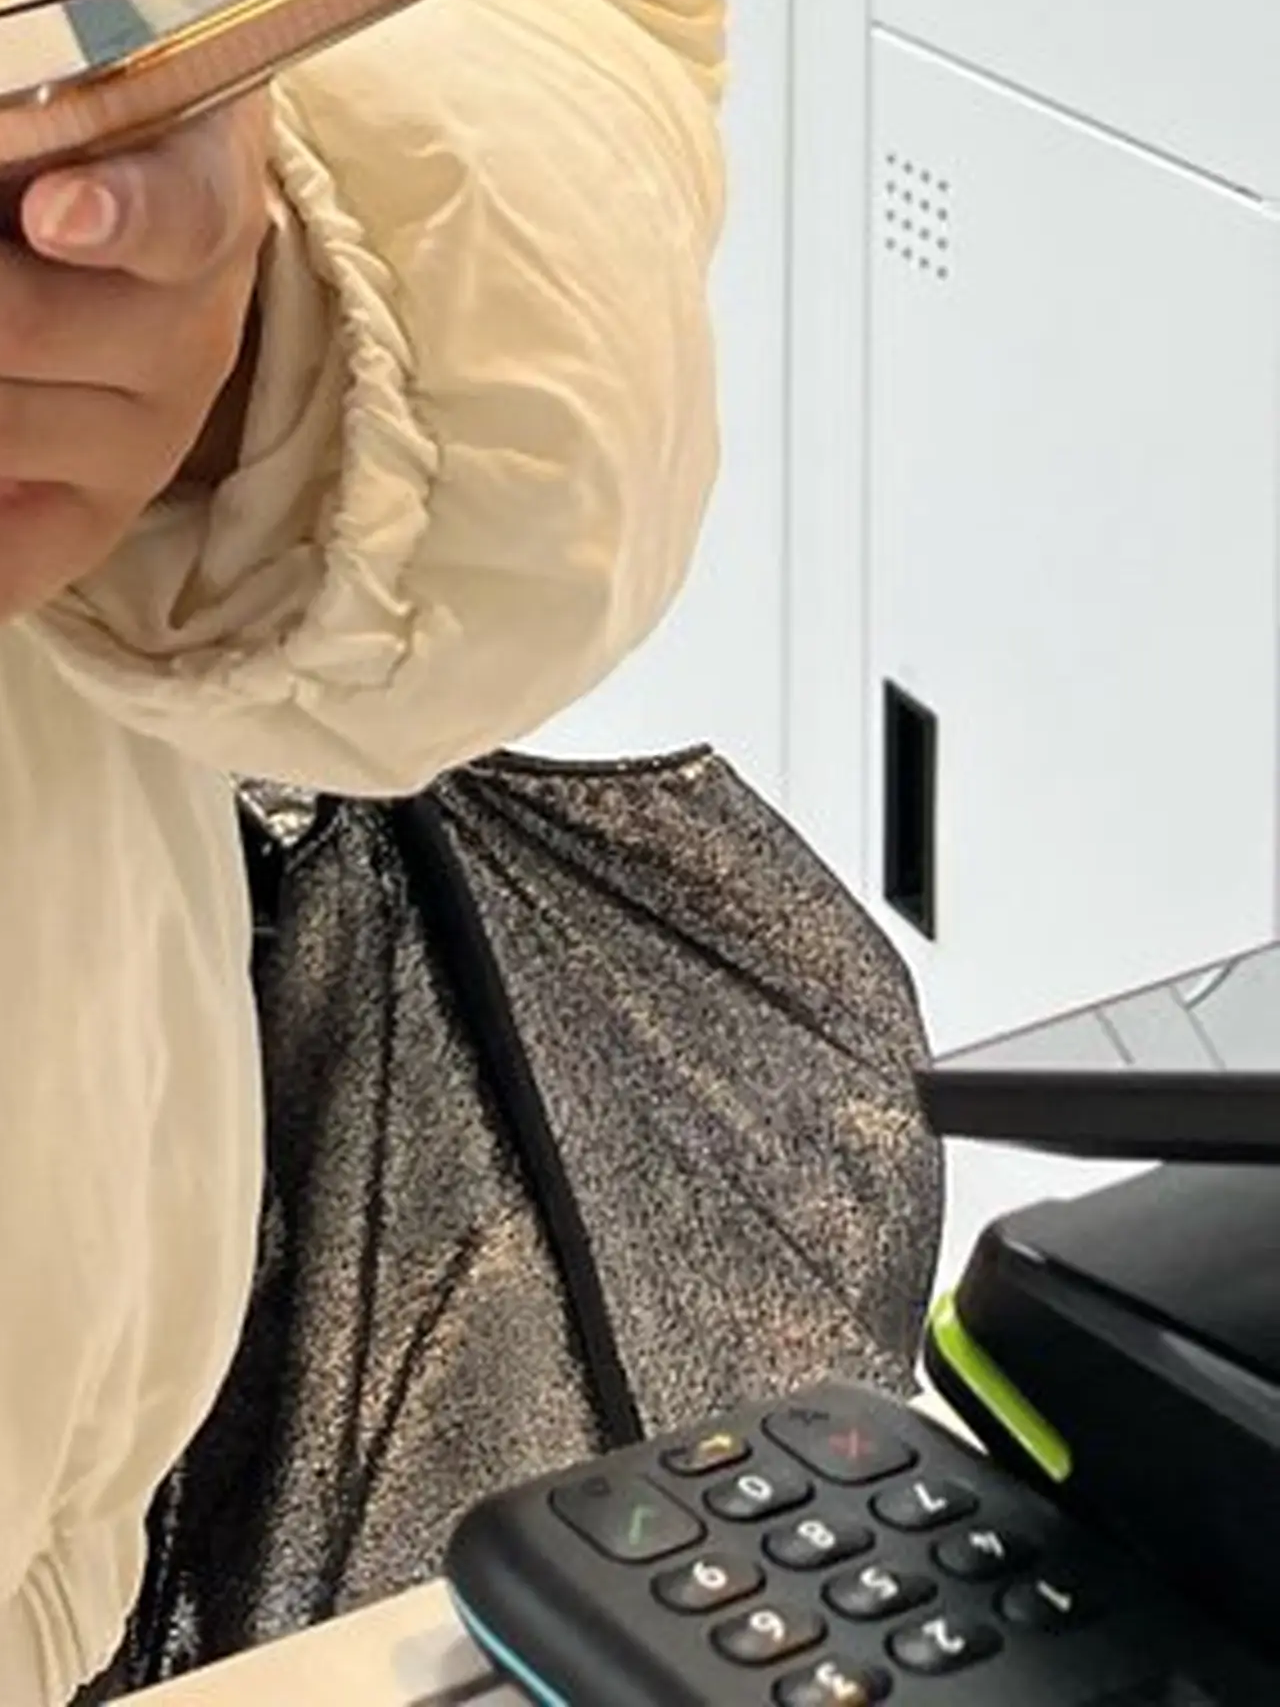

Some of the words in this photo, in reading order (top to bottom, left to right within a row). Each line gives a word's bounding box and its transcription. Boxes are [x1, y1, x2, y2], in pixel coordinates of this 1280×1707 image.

[738, 1475, 773, 1502] 0
[912, 1482, 947, 1513] 7
[796, 1519, 837, 1551] 8
[859, 1566, 899, 1600] 5
[920, 1619, 965, 1654] 2
[814, 1660, 858, 1700] 3
